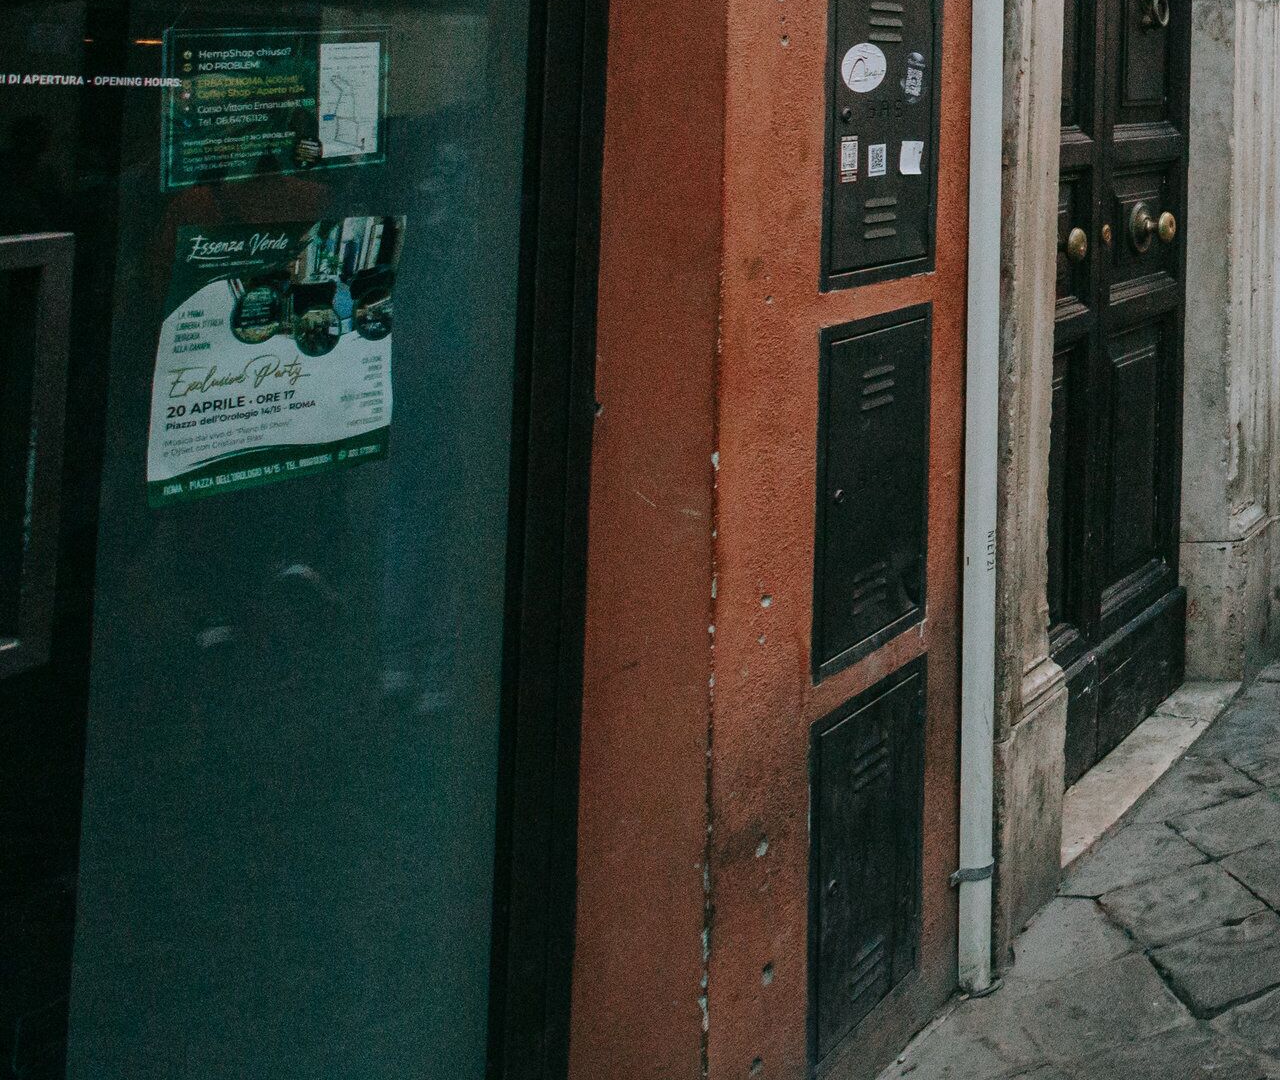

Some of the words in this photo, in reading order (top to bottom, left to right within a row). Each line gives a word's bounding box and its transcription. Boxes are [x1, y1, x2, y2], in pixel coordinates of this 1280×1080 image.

[198, 48, 255, 61] HempShop
[198, 62, 214, 72] NO
[8, 73, 21, 85] DI
[22, 74, 84, 86] APERTURA
[94, 75, 142, 87] OPENING
[143, 76, 183, 88] HOURS:
[197, 105, 222, 115] Corso
[186, 233, 245, 263] Essenza
[249, 232, 290, 256] Verde
[244, 354, 311, 389] Party
[165, 419, 197, 431] Piazza
[289, 399, 316, 411] ROMA
[166, 405, 186, 419] 20
[191, 395, 246, 414] APRILE
[256, 393, 281, 405] ORE
[283, 389, 296, 401] 17
